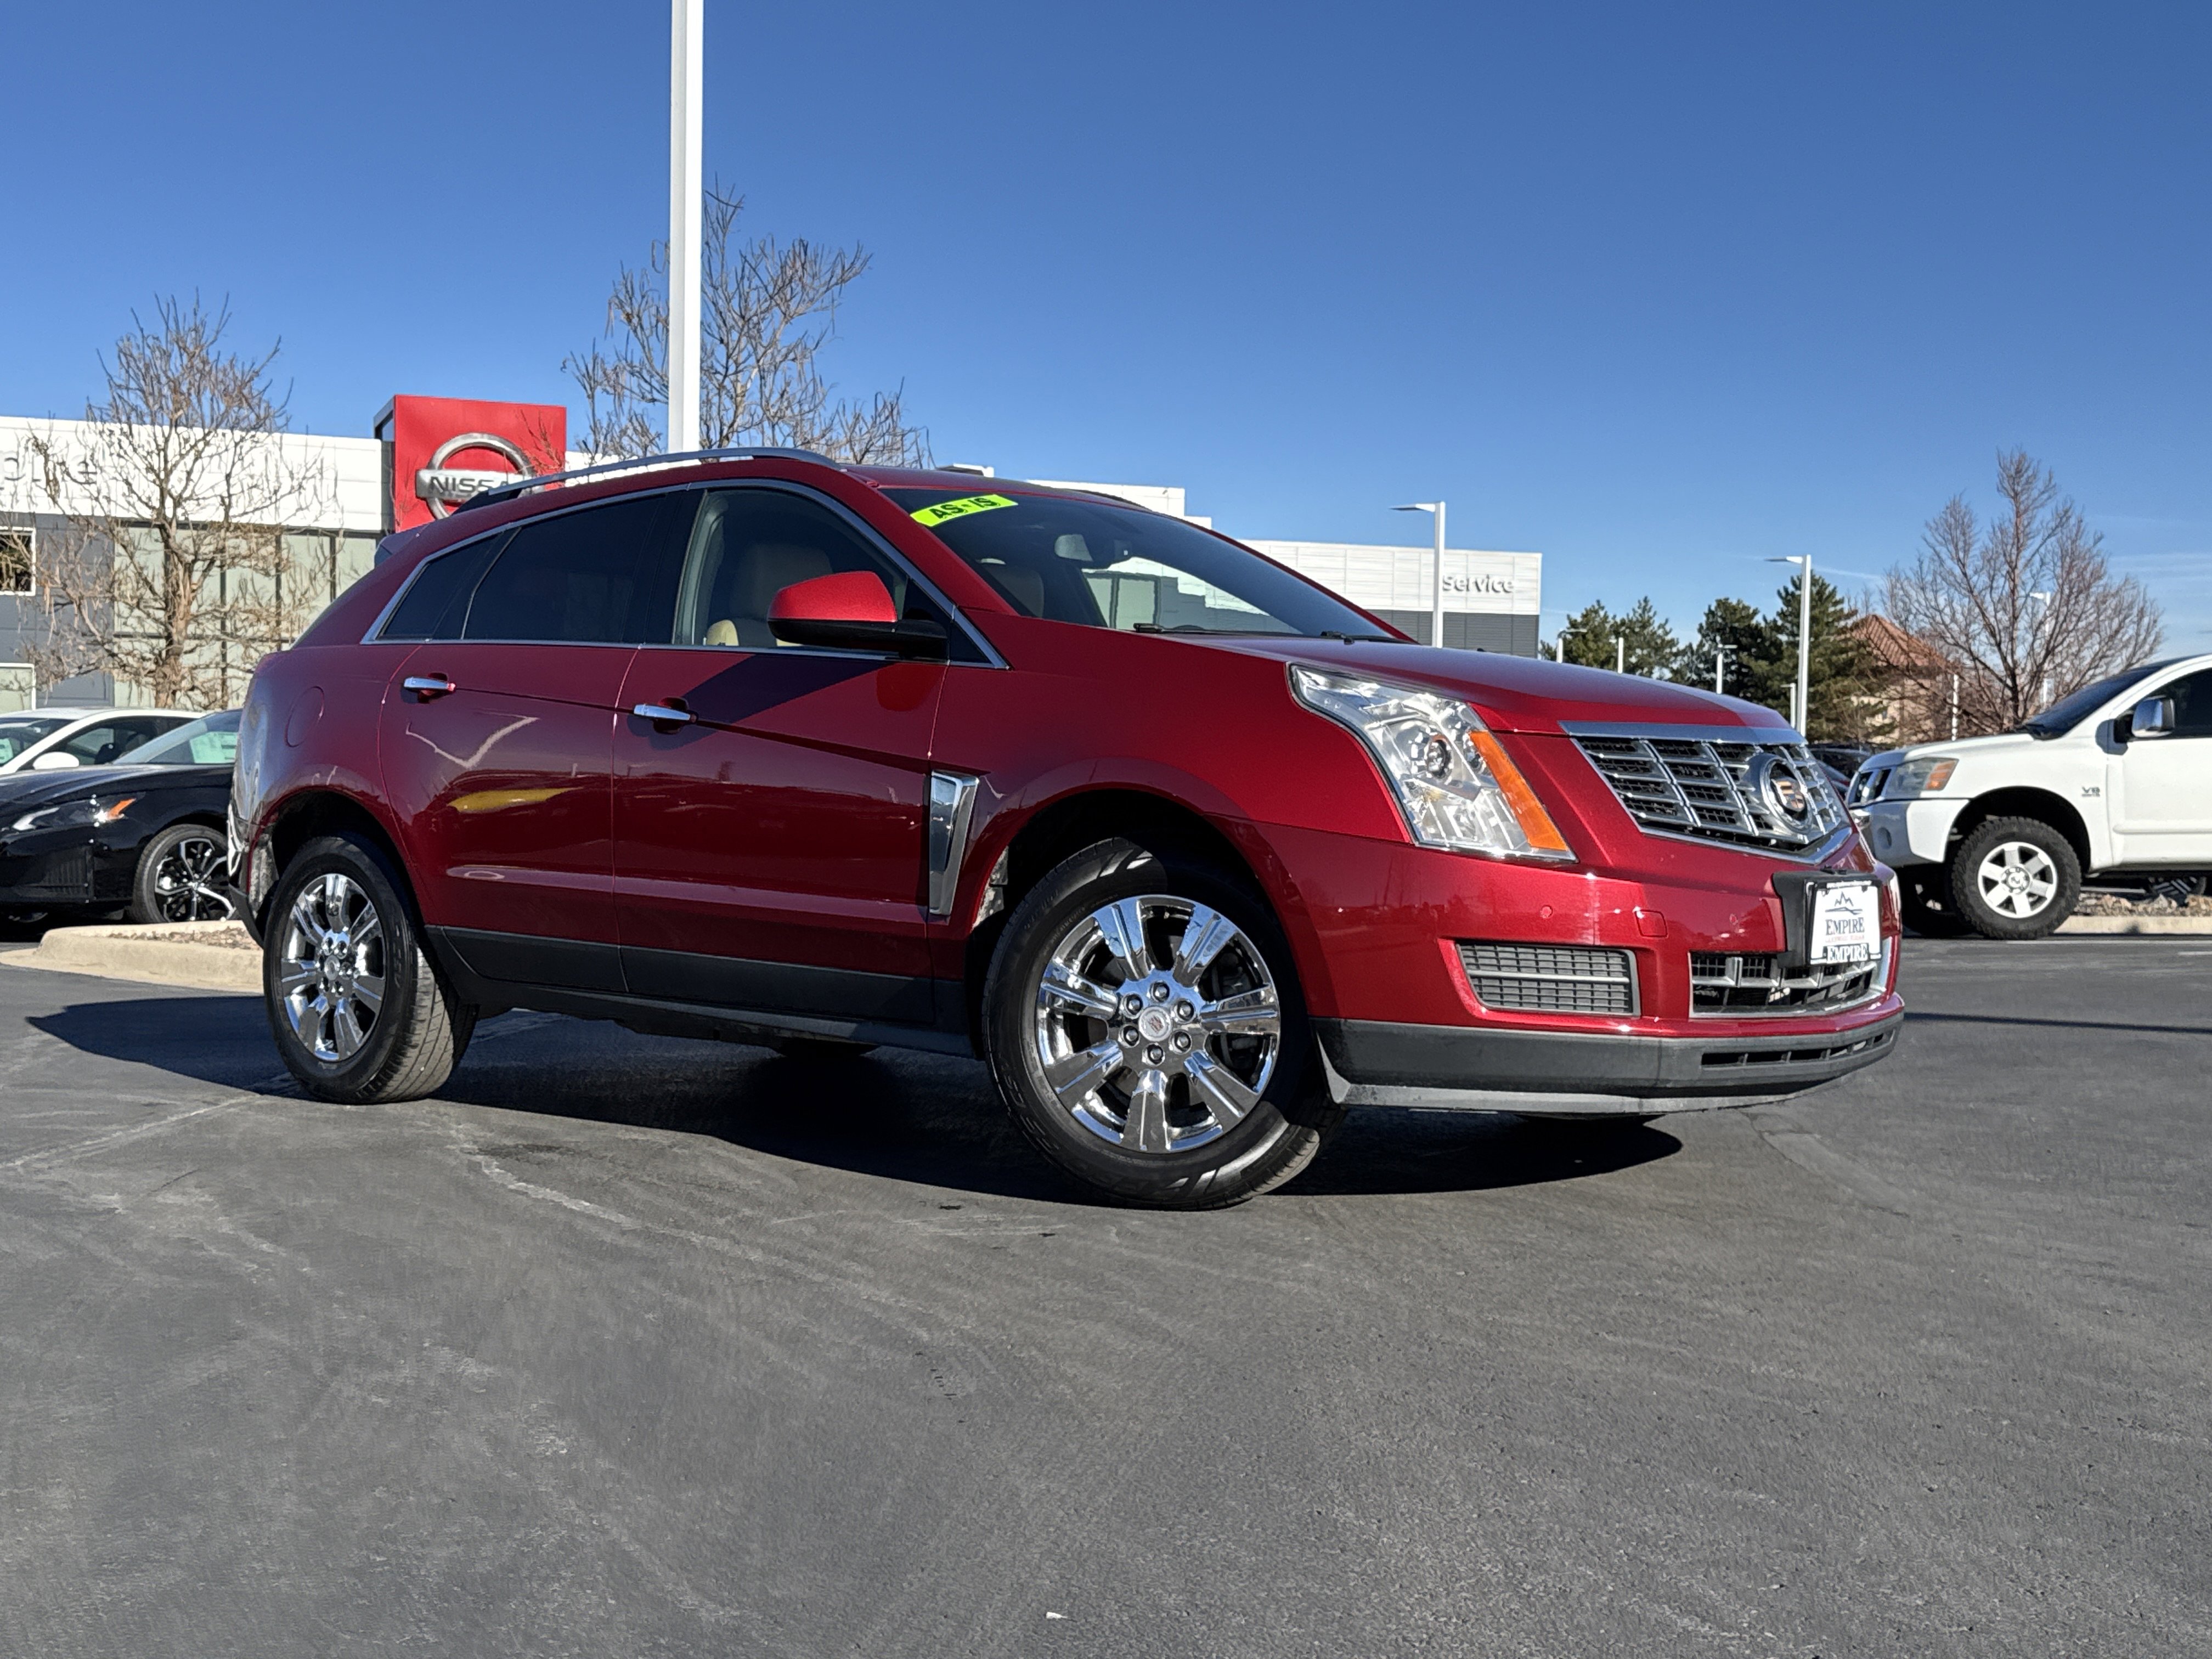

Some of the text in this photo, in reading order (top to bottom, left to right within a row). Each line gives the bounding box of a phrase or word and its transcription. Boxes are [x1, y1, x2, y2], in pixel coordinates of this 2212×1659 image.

[430, 476, 509, 493] NISS
[1825, 917, 1865, 935] EMPIRE
[1827, 943, 1867, 963] EMPIRE
